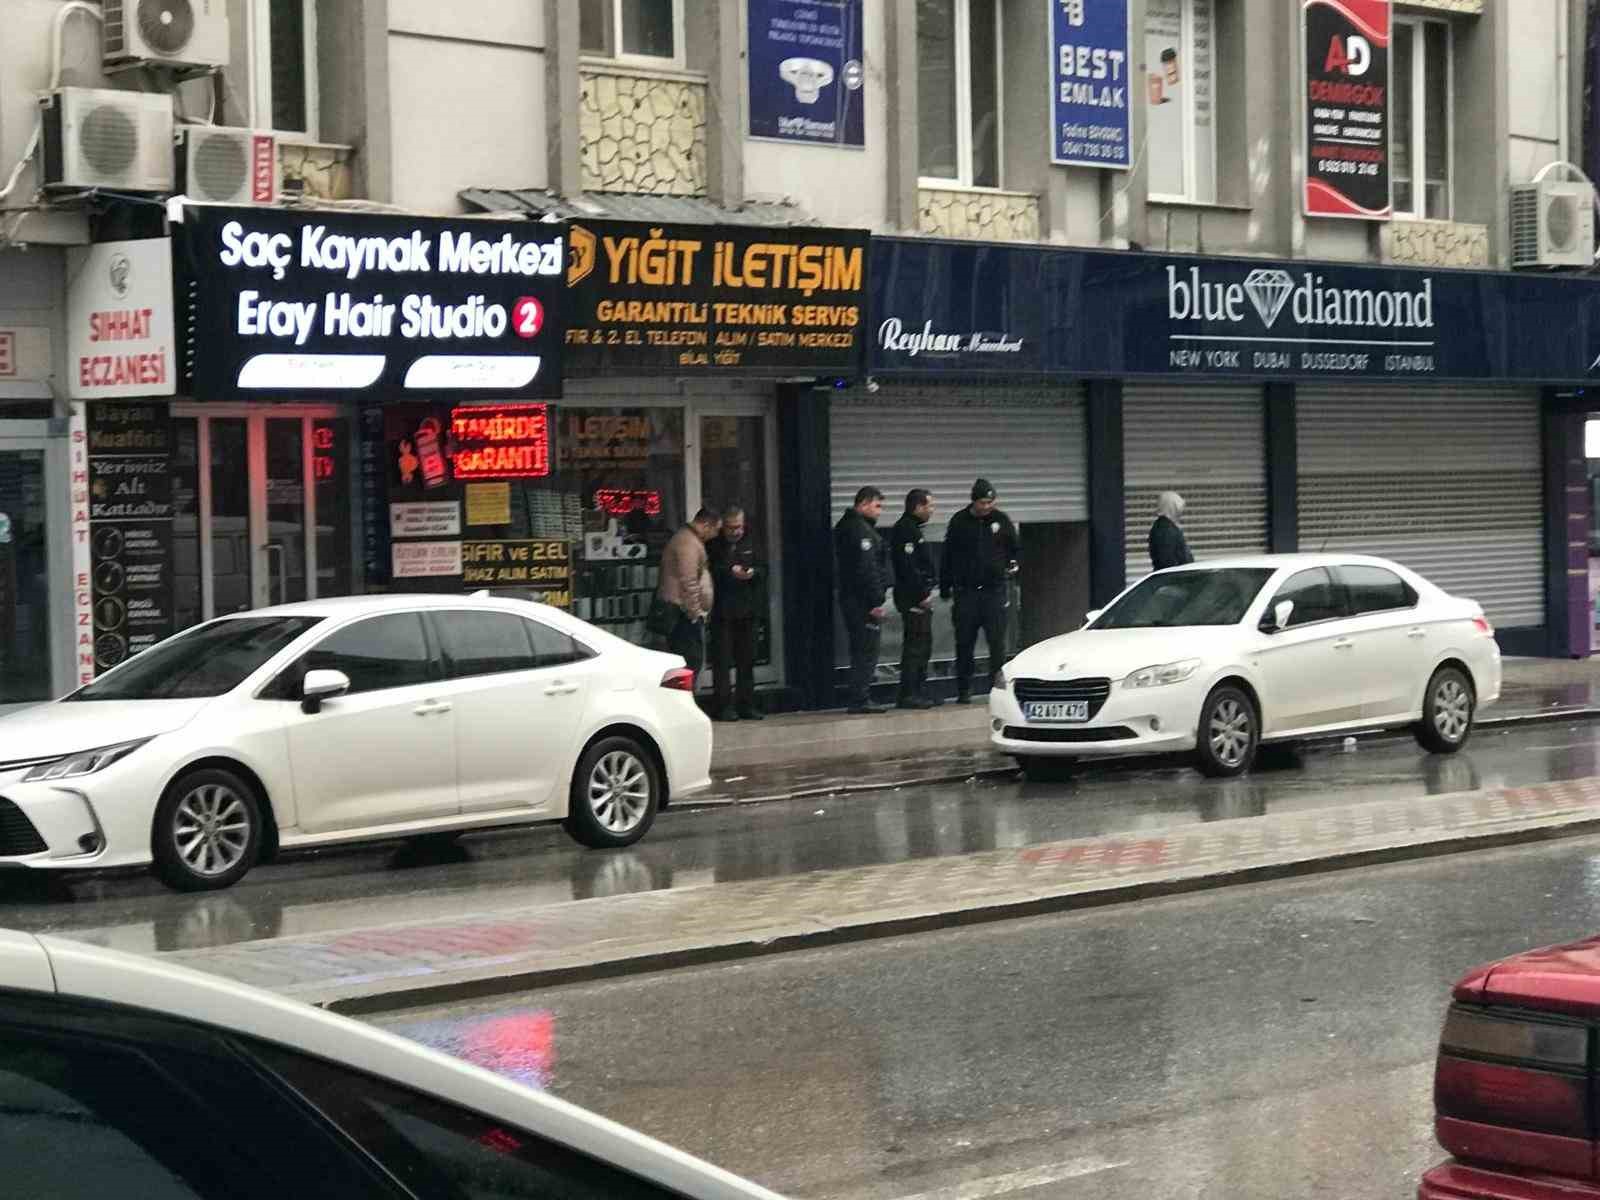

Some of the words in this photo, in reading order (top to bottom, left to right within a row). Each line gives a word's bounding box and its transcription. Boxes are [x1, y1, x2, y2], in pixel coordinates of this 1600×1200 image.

[1060, 45, 1124, 80] BEST
[1324, 34, 1371, 76] AD
[1060, 82, 1125, 109] EMLAK
[256, 139, 270, 200] VESTEL
[219, 221, 293, 280] Saç
[301, 225, 431, 279] Kaynak
[439, 231, 563, 275] Merkezi
[603, 227, 702, 286] YİĞİT
[713, 241, 863, 297] İLETİŞİM
[597, 300, 709, 323] GARANTİLİ
[713, 303, 788, 325] TEKNİK
[792, 305, 860, 327] SERVİS
[1166, 265, 1245, 321] blue
[1293, 273, 1434, 327] diamond
[90, 308, 153, 342] SIHHAT
[238, 290, 317, 345] Eray
[324, 292, 396, 336] Hair
[400, 294, 507, 338] Studio
[518, 301, 538, 334] 2
[625, 330, 643, 345] EL
[646, 330, 708, 345] TELEFON
[714, 332, 747, 346] ALIM
[758, 332, 794, 347] SATIM
[878, 317, 961, 357] Reyhan
[1170, 351, 1200, 368] NEW
[1206, 351, 1240, 368] YORK
[1253, 353, 1290, 369] DUBAI
[1031, 703, 1043, 717] 42
